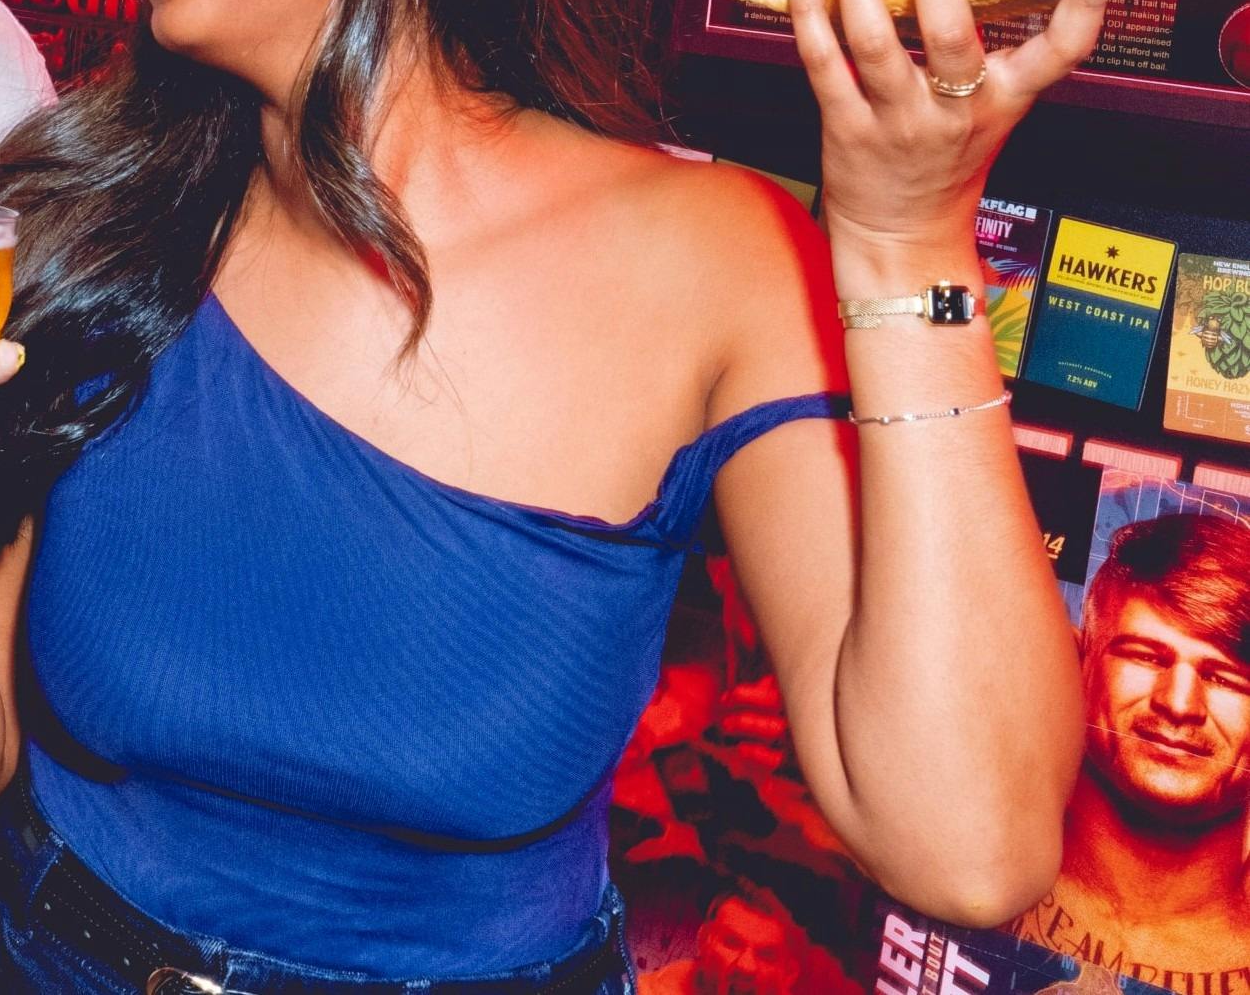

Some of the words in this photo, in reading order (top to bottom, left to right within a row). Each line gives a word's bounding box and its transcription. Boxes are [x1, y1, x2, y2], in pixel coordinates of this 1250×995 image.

[1160, 1, 1177, 10] that
[750, 12, 778, 23] delivery
[1130, 10, 1160, 22] making
[1162, 13, 1175, 22] his
[1103, 31, 1116, 40] He
[1118, 34, 1172, 47] immortalised
[1101, 43, 1115, 52] Old
[1118, 45, 1151, 57] Trafford
[1152, 49, 1170, 59] with
[1106, 57, 1121, 66] clip
[1123, 58, 1135, 67] his
[1137, 60, 1148, 69] off
[1058, 254, 1158, 294] HAWKERS
[1203, 275, 1232, 292] HOP
[1048, 295, 1080, 312] WEST
[1085, 305, 1125, 323] COAST
[1129, 316, 1150, 330] IPA
[1082, 376, 1099, 389] ABV
[1186, 375, 1222, 391] HONEY
[927, 932, 945, 982] BOUT
